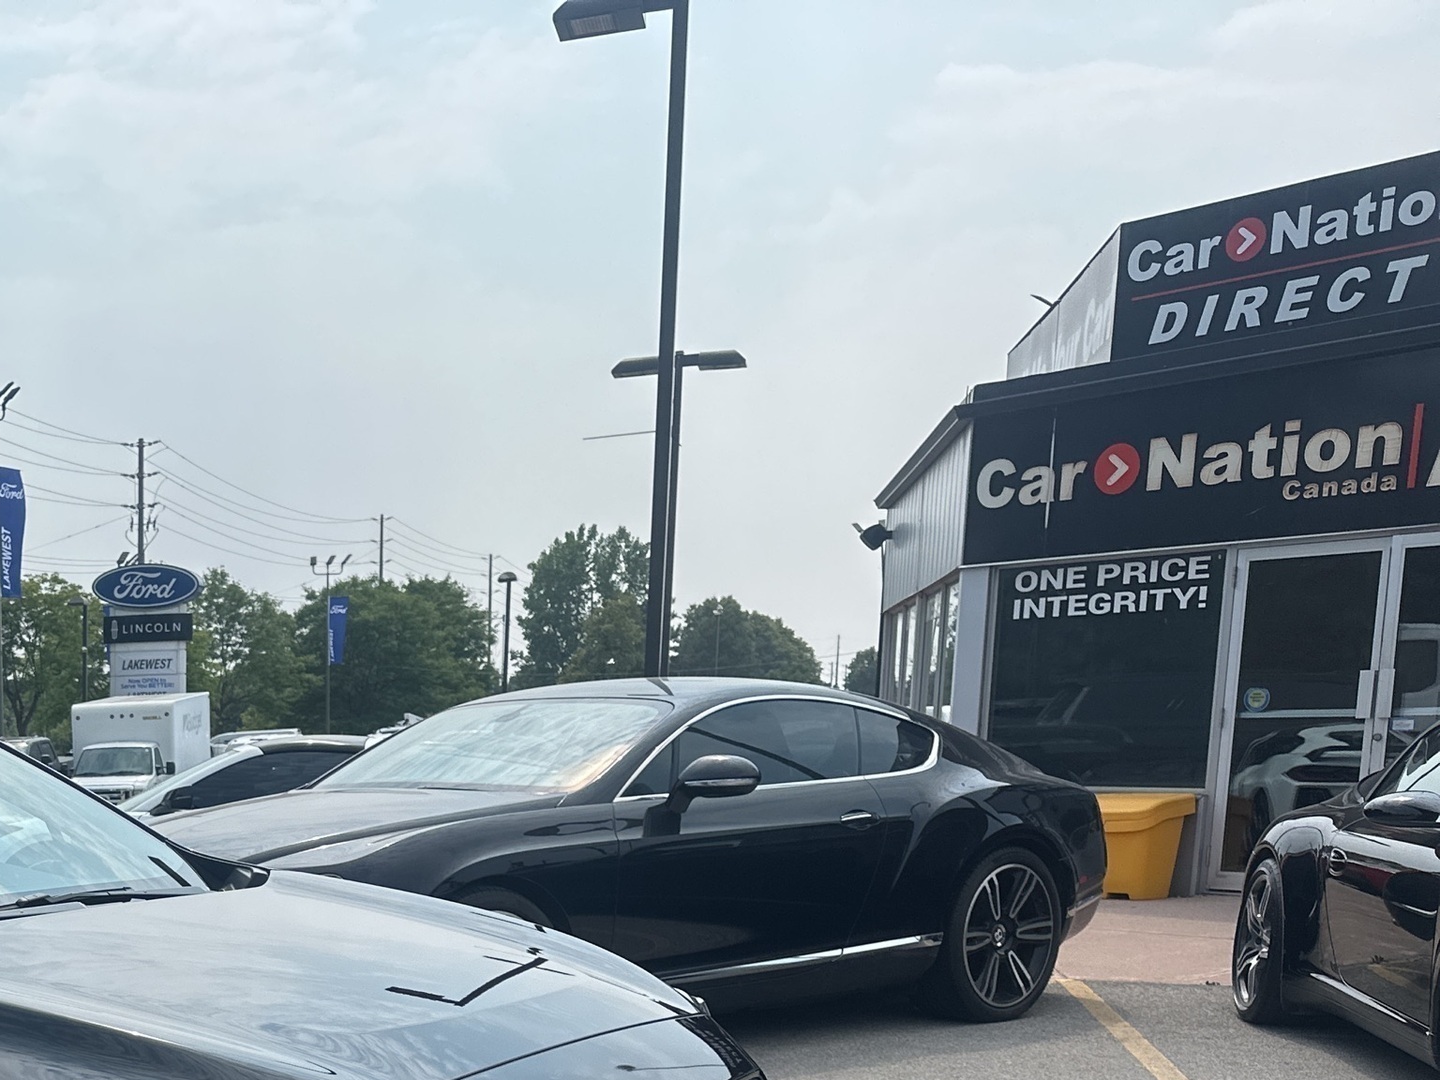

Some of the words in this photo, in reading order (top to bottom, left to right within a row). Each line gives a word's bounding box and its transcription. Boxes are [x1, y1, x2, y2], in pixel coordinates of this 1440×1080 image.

[1127, 235, 1222, 282] Car
[1269, 187, 1440, 255] Natio
[1148, 254, 1429, 345] DIRECT
[976, 458, 1089, 509] Car
[1146, 419, 1404, 491] Nation
[1282, 473, 1398, 500] Canada
[1, 526, 12, 590] LAKEWEST
[1014, 566, 1088, 593] ONE
[1096, 556, 1212, 587] PRICE
[113, 571, 177, 599] Ford
[330, 605, 348, 614] Ford
[1012, 586, 1209, 620] INTEGRITY!
[122, 623, 181, 634] LINCOLN
[122, 658, 173, 671] LAKEWEST
